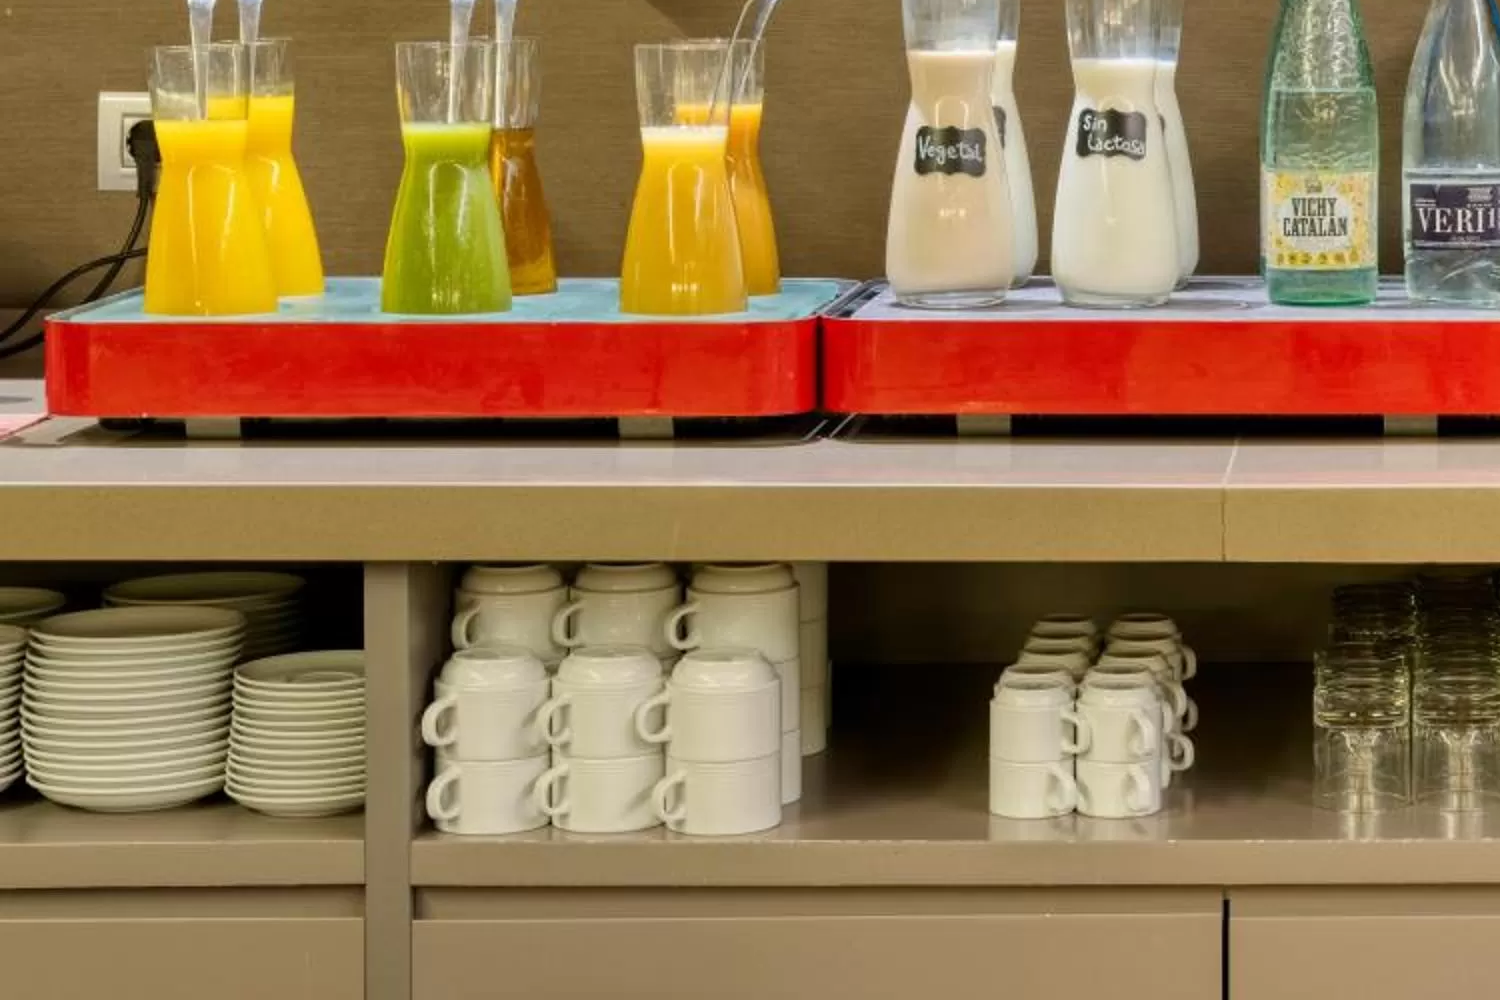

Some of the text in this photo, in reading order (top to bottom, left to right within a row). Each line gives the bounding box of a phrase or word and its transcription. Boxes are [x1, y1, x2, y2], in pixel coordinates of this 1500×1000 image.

[1082, 115, 1108, 132] Sin
[917, 135, 983, 164] Vegetal
[1291, 198, 1338, 217] VICHY
[1283, 218, 1348, 237] CATALAN
